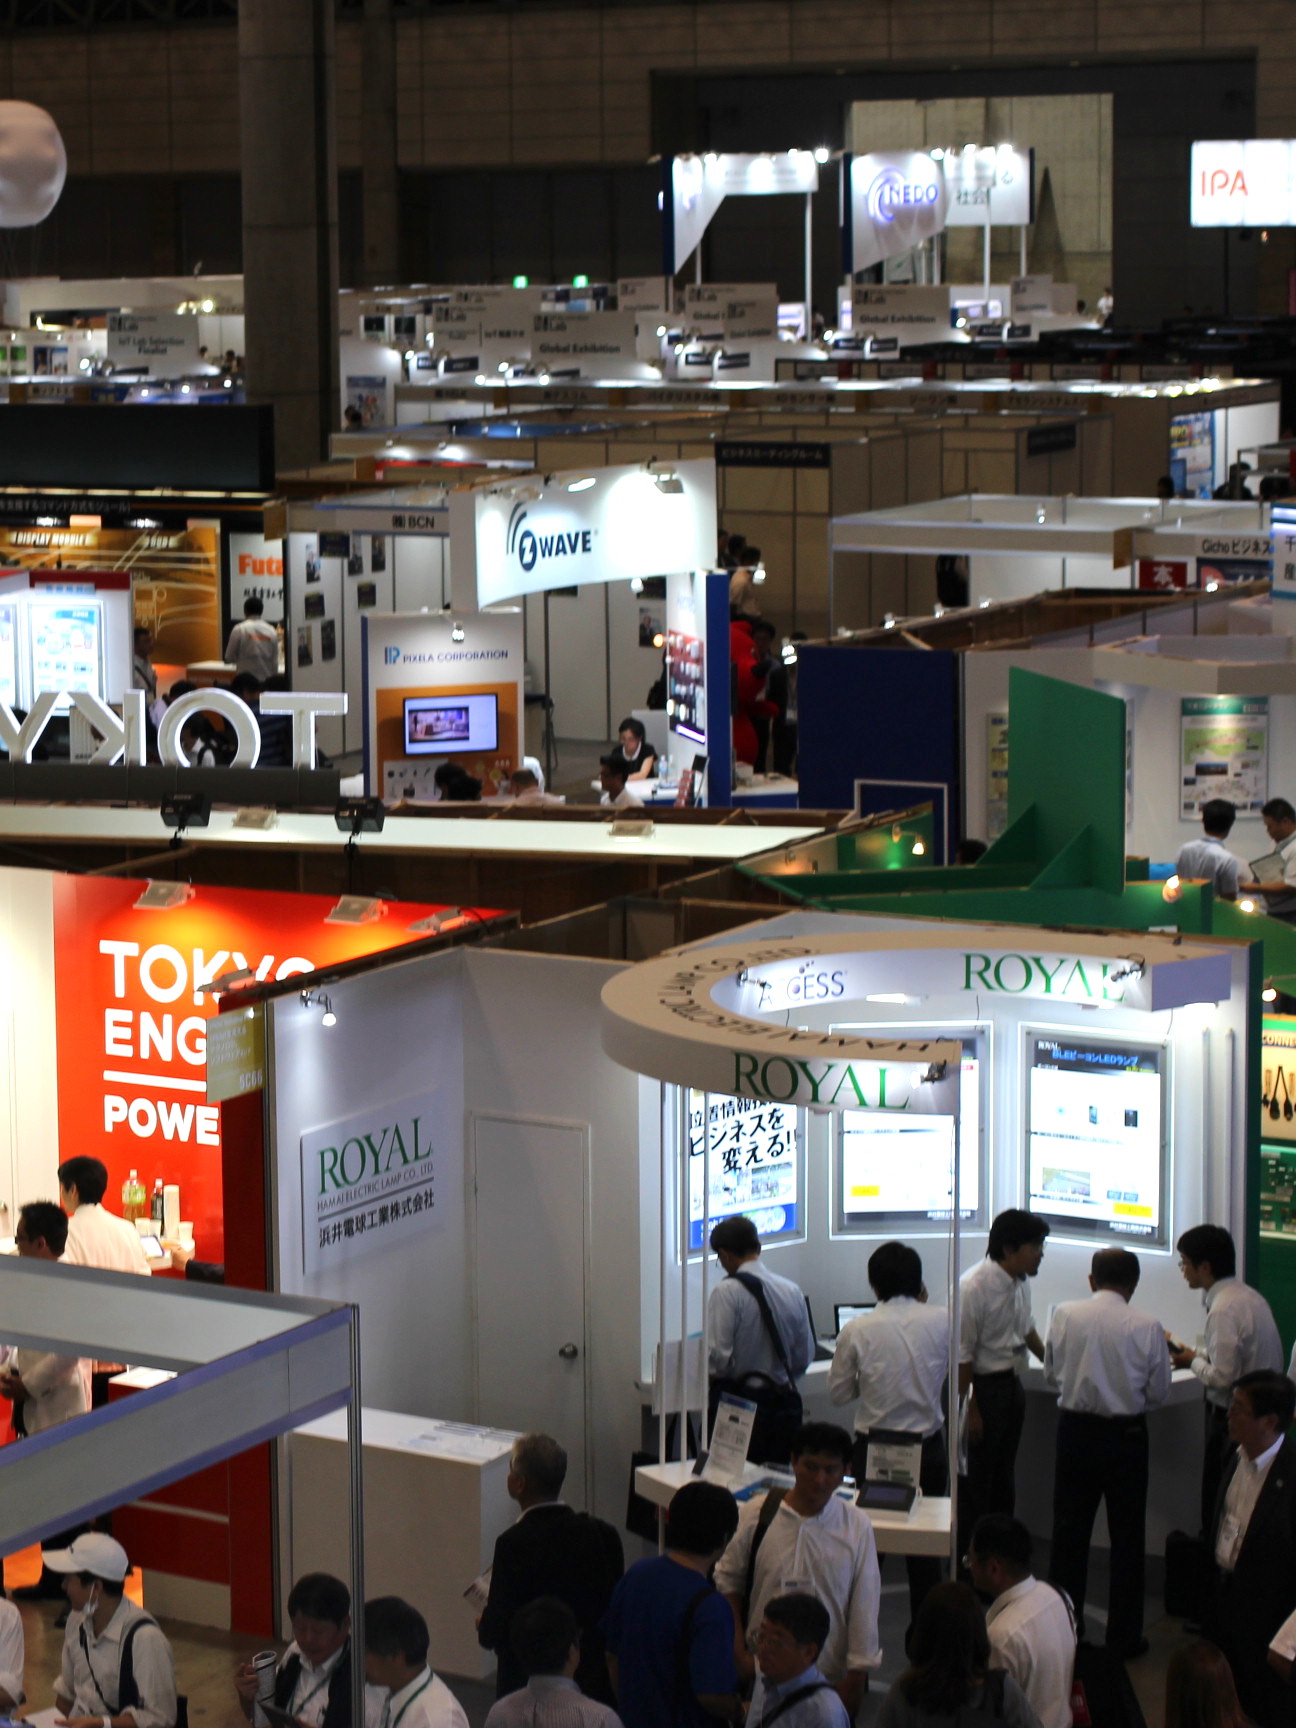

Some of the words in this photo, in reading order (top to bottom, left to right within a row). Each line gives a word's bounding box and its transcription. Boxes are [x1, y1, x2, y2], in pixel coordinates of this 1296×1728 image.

[1201, 168, 1250, 197] IPA
[539, 531, 592, 558] WAVE
[403, 654, 435, 664] PIXELA
[437, 649, 509, 663] CORPORATION
[962, 952, 1126, 1002] ROYAL
[105, 1008, 207, 1065] ENG
[733, 1051, 910, 1111] ROYAL
[104, 1094, 220, 1146] POWE
[690, 1107, 784, 1157] ビジネスを
[318, 1116, 434, 1196] ROYAL
[317, 1193, 345, 1212] HAMAI
[345, 1182, 380, 1201] ELECTRIC
[381, 1173, 402, 1190] LAMP
[319, 1187, 435, 1249] 浜井電球工業株式会社
